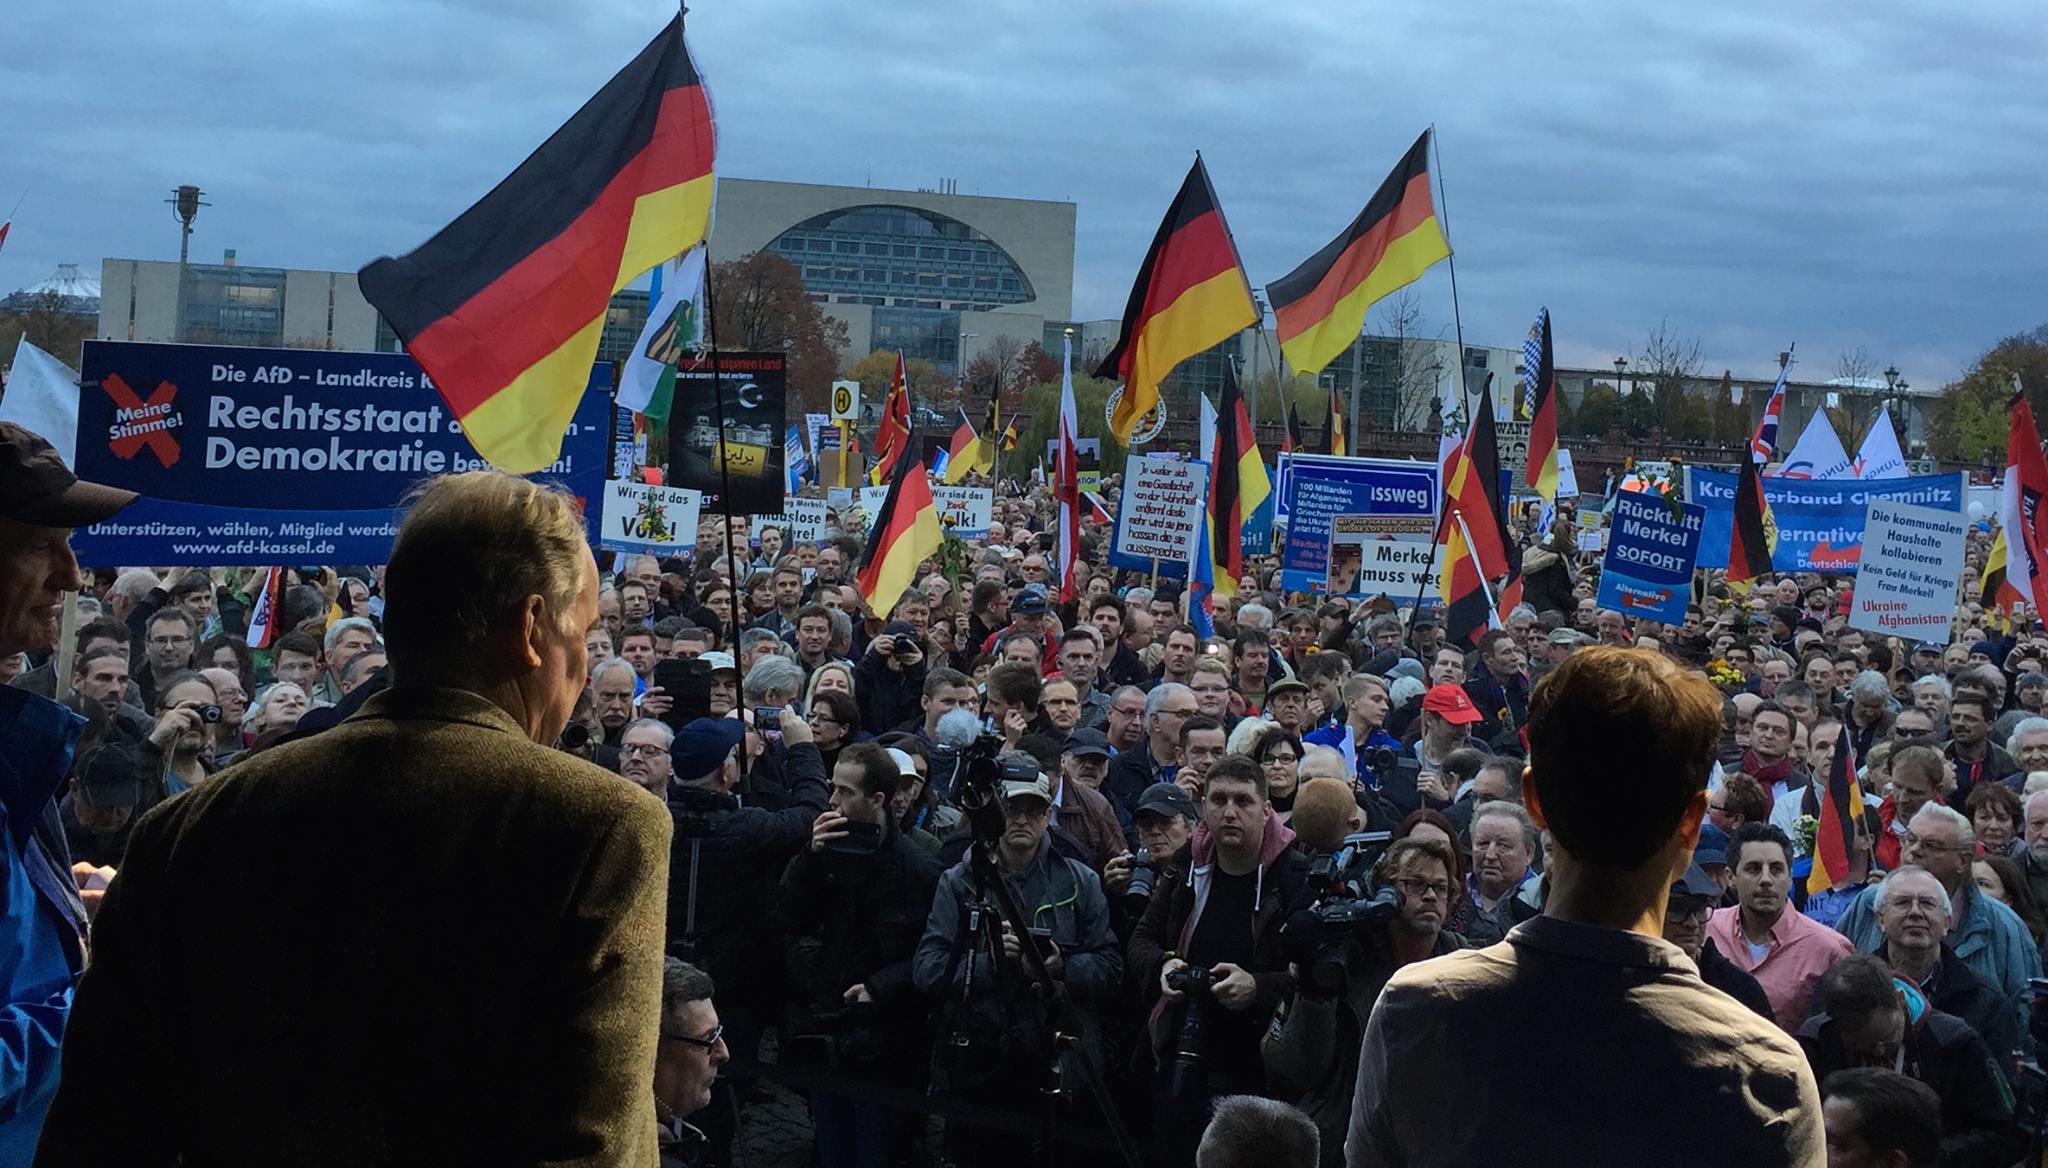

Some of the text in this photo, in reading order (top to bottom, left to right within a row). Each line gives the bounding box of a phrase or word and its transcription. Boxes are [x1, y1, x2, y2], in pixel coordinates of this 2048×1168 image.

[211, 365, 247, 383] Die
[252, 366, 293, 384] AfD
[316, 368, 414, 389] Landkreis
[115, 402, 172, 424] Meine
[208, 395, 443, 433] Rechtsstaat
[109, 413, 184, 441] Stimme!
[1495, 422, 1530, 435] WANT
[205, 436, 446, 472] Demokratie
[1174, 466, 1188, 477] sich
[869, 490, 886, 498] Wir
[1138, 479, 1194, 493] eine Gesellschaft
[1315, 484, 1353, 496] Milliarden
[617, 486, 638, 499] Wir
[668, 492, 689, 504] das
[949, 489, 966, 499] sind
[969, 491, 984, 500] das
[1134, 490, 1198, 505] von der Wahrheit
[1298, 491, 1309, 499] für
[1135, 501, 1186, 518] entfernt desto
[1297, 500, 1345, 512] Milliarden für
[1128, 514, 1194, 532] mehr wird sie jene
[1312, 526, 1322, 534] für
[1871, 509, 1963, 535] Die kommunalen
[87, 522, 400, 540] Unterstützen, wählen, Mitglied werde
[1128, 526, 1186, 545] hassen die sie
[1622, 519, 1689, 547] Merkel
[1887, 529, 1942, 549] Haushalte
[172, 540, 336, 554] www.afd-kassel.de
[1126, 543, 1187, 559] aussprechen
[1616, 544, 1686, 571] SOFORT
[1881, 545, 1942, 566] kollabieren
[1362, 569, 1405, 583] muss
[1862, 563, 1954, 590] Kein Geld für Kriege
[1877, 580, 1897, 592] Frau
[1862, 600, 1908, 613] Ukraine
[1878, 614, 1947, 629] Afghanistan
